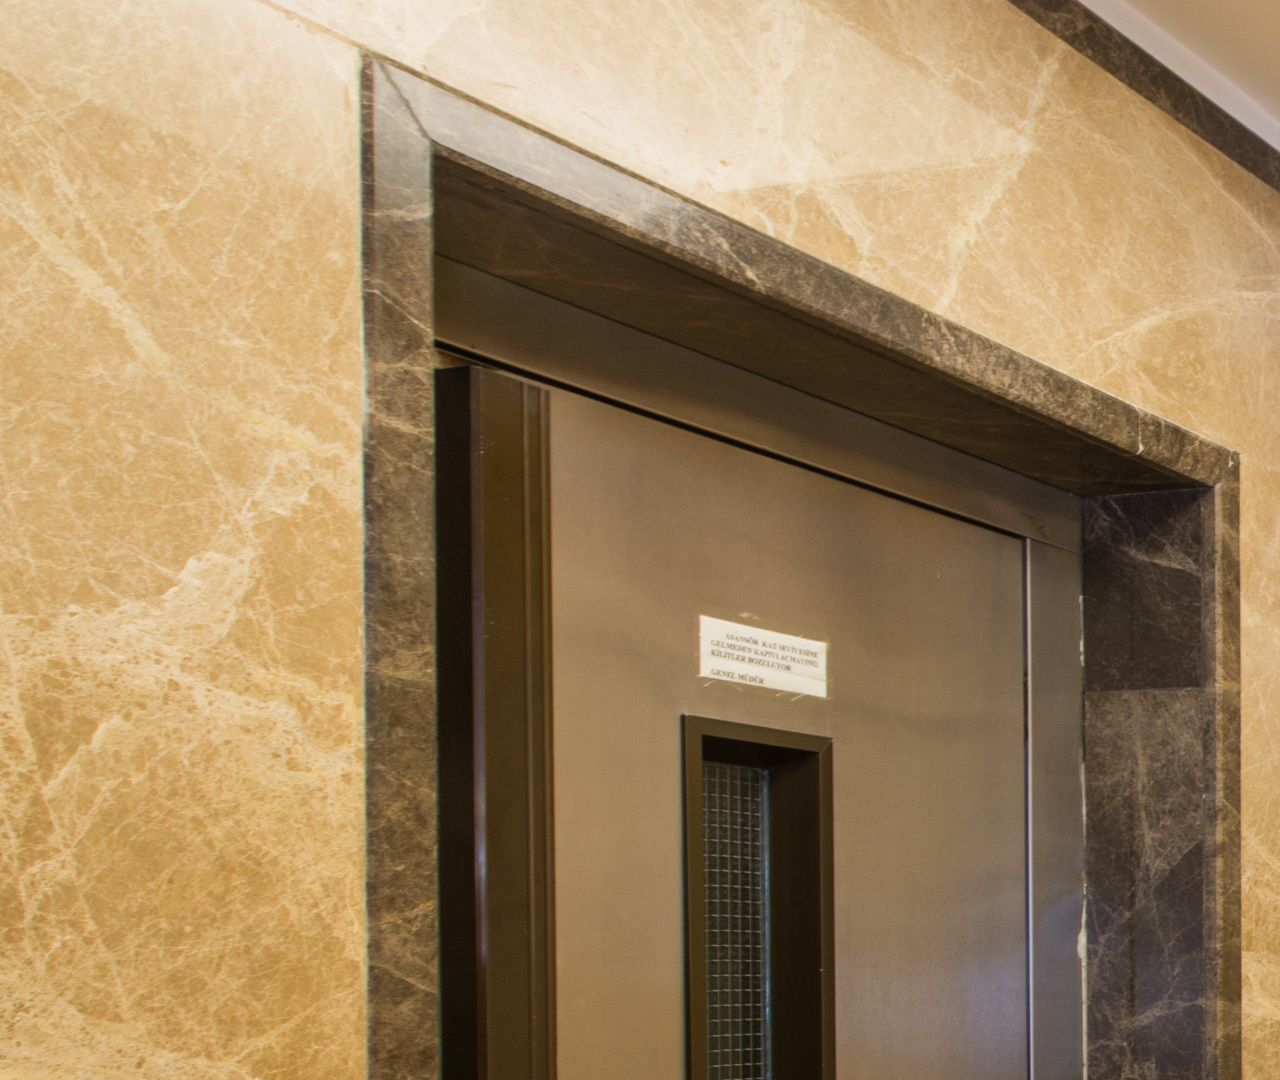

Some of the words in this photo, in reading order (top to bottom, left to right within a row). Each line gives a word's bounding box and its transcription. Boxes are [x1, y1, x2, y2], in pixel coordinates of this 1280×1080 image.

[711, 640, 752, 653] GELMEDEN
[761, 641, 777, 650] KAT
[711, 669, 735, 679] GENEL
